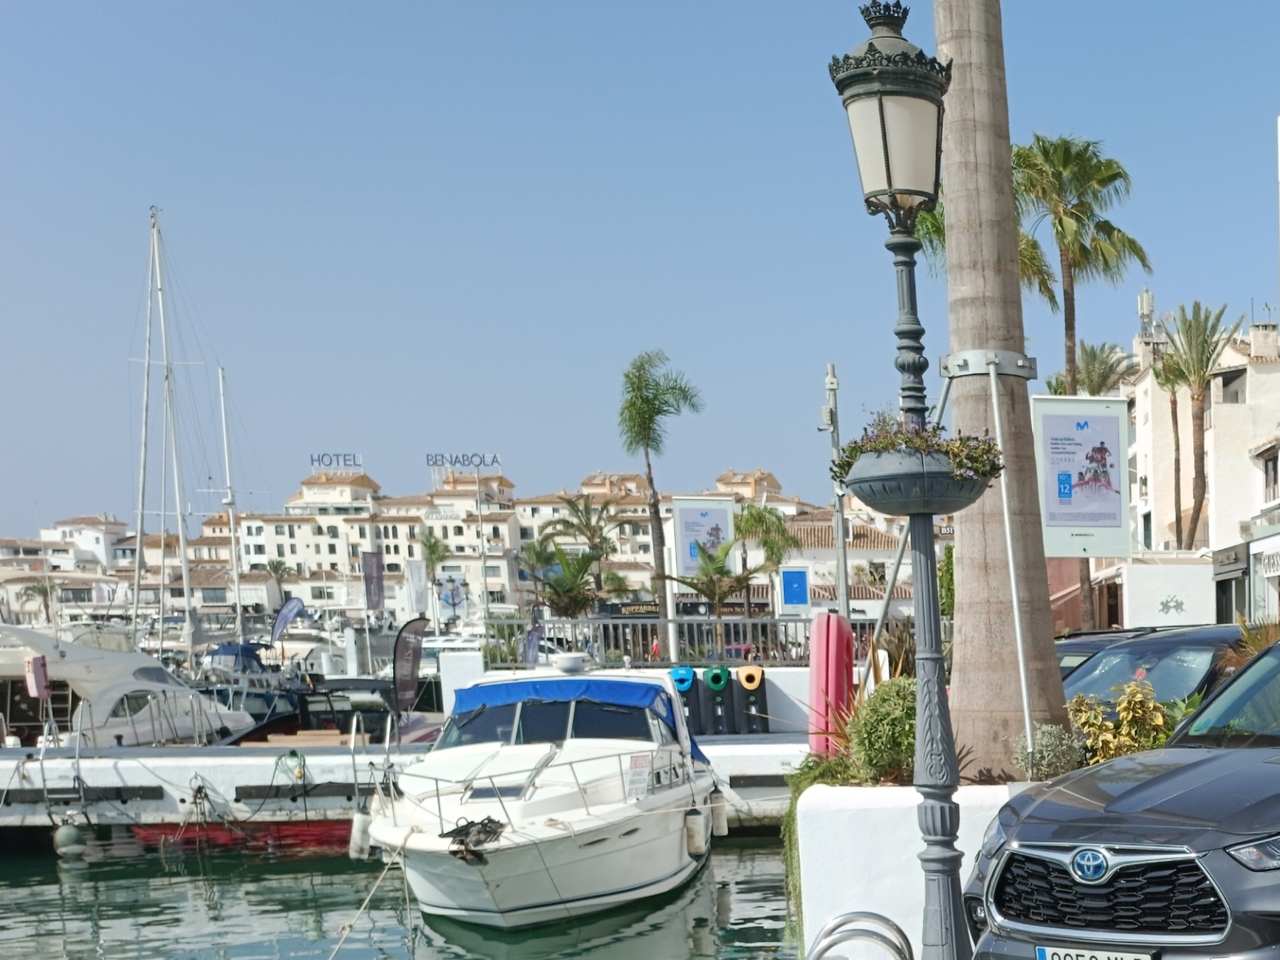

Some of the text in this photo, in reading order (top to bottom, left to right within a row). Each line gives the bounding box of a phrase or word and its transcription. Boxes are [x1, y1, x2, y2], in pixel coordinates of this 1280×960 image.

[310, 453, 363, 467] HOTEL
[426, 453, 501, 467] BENABOLA
[1060, 485, 1070, 493] 12
